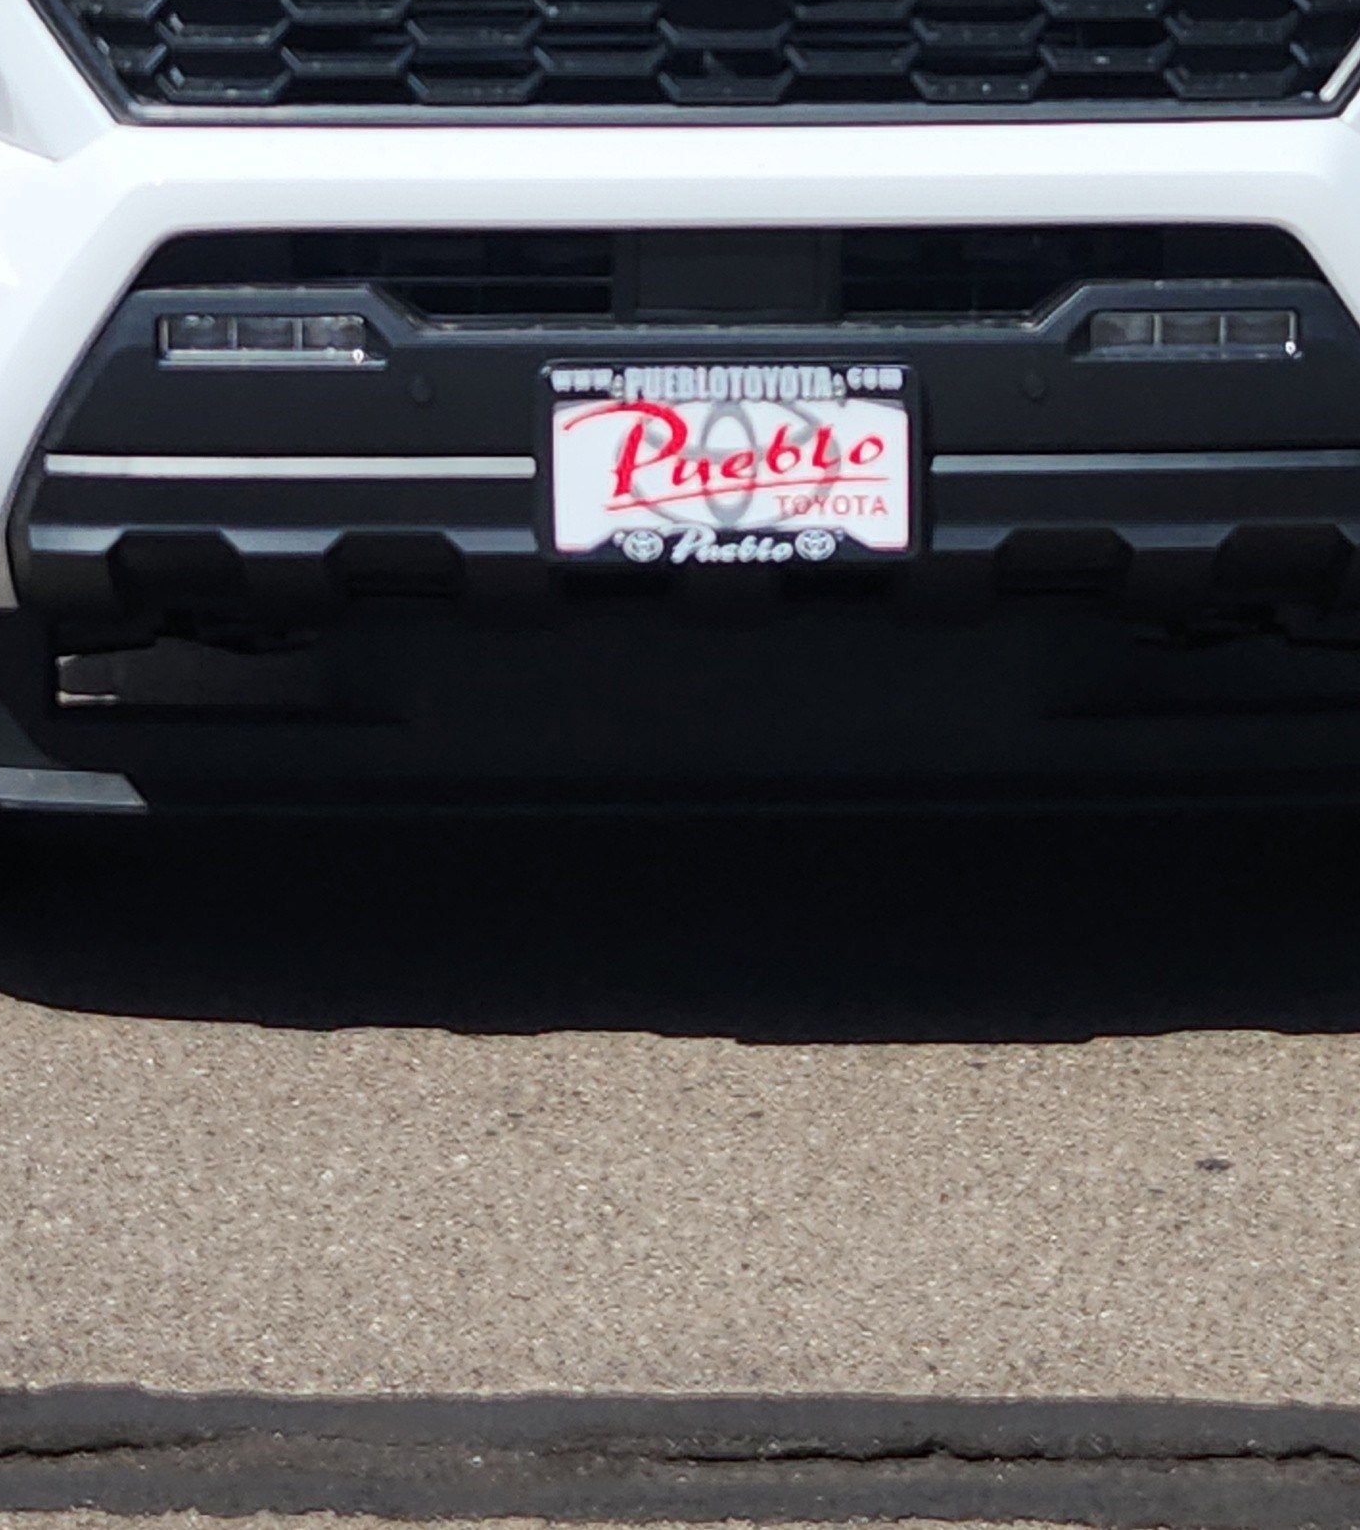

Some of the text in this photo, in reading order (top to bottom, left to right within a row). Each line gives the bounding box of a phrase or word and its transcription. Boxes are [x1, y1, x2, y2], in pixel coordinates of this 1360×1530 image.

[563, 400, 885, 498] Pueblo
[775, 494, 889, 516] TOYOTA
[663, 523, 794, 564] Pueblo
